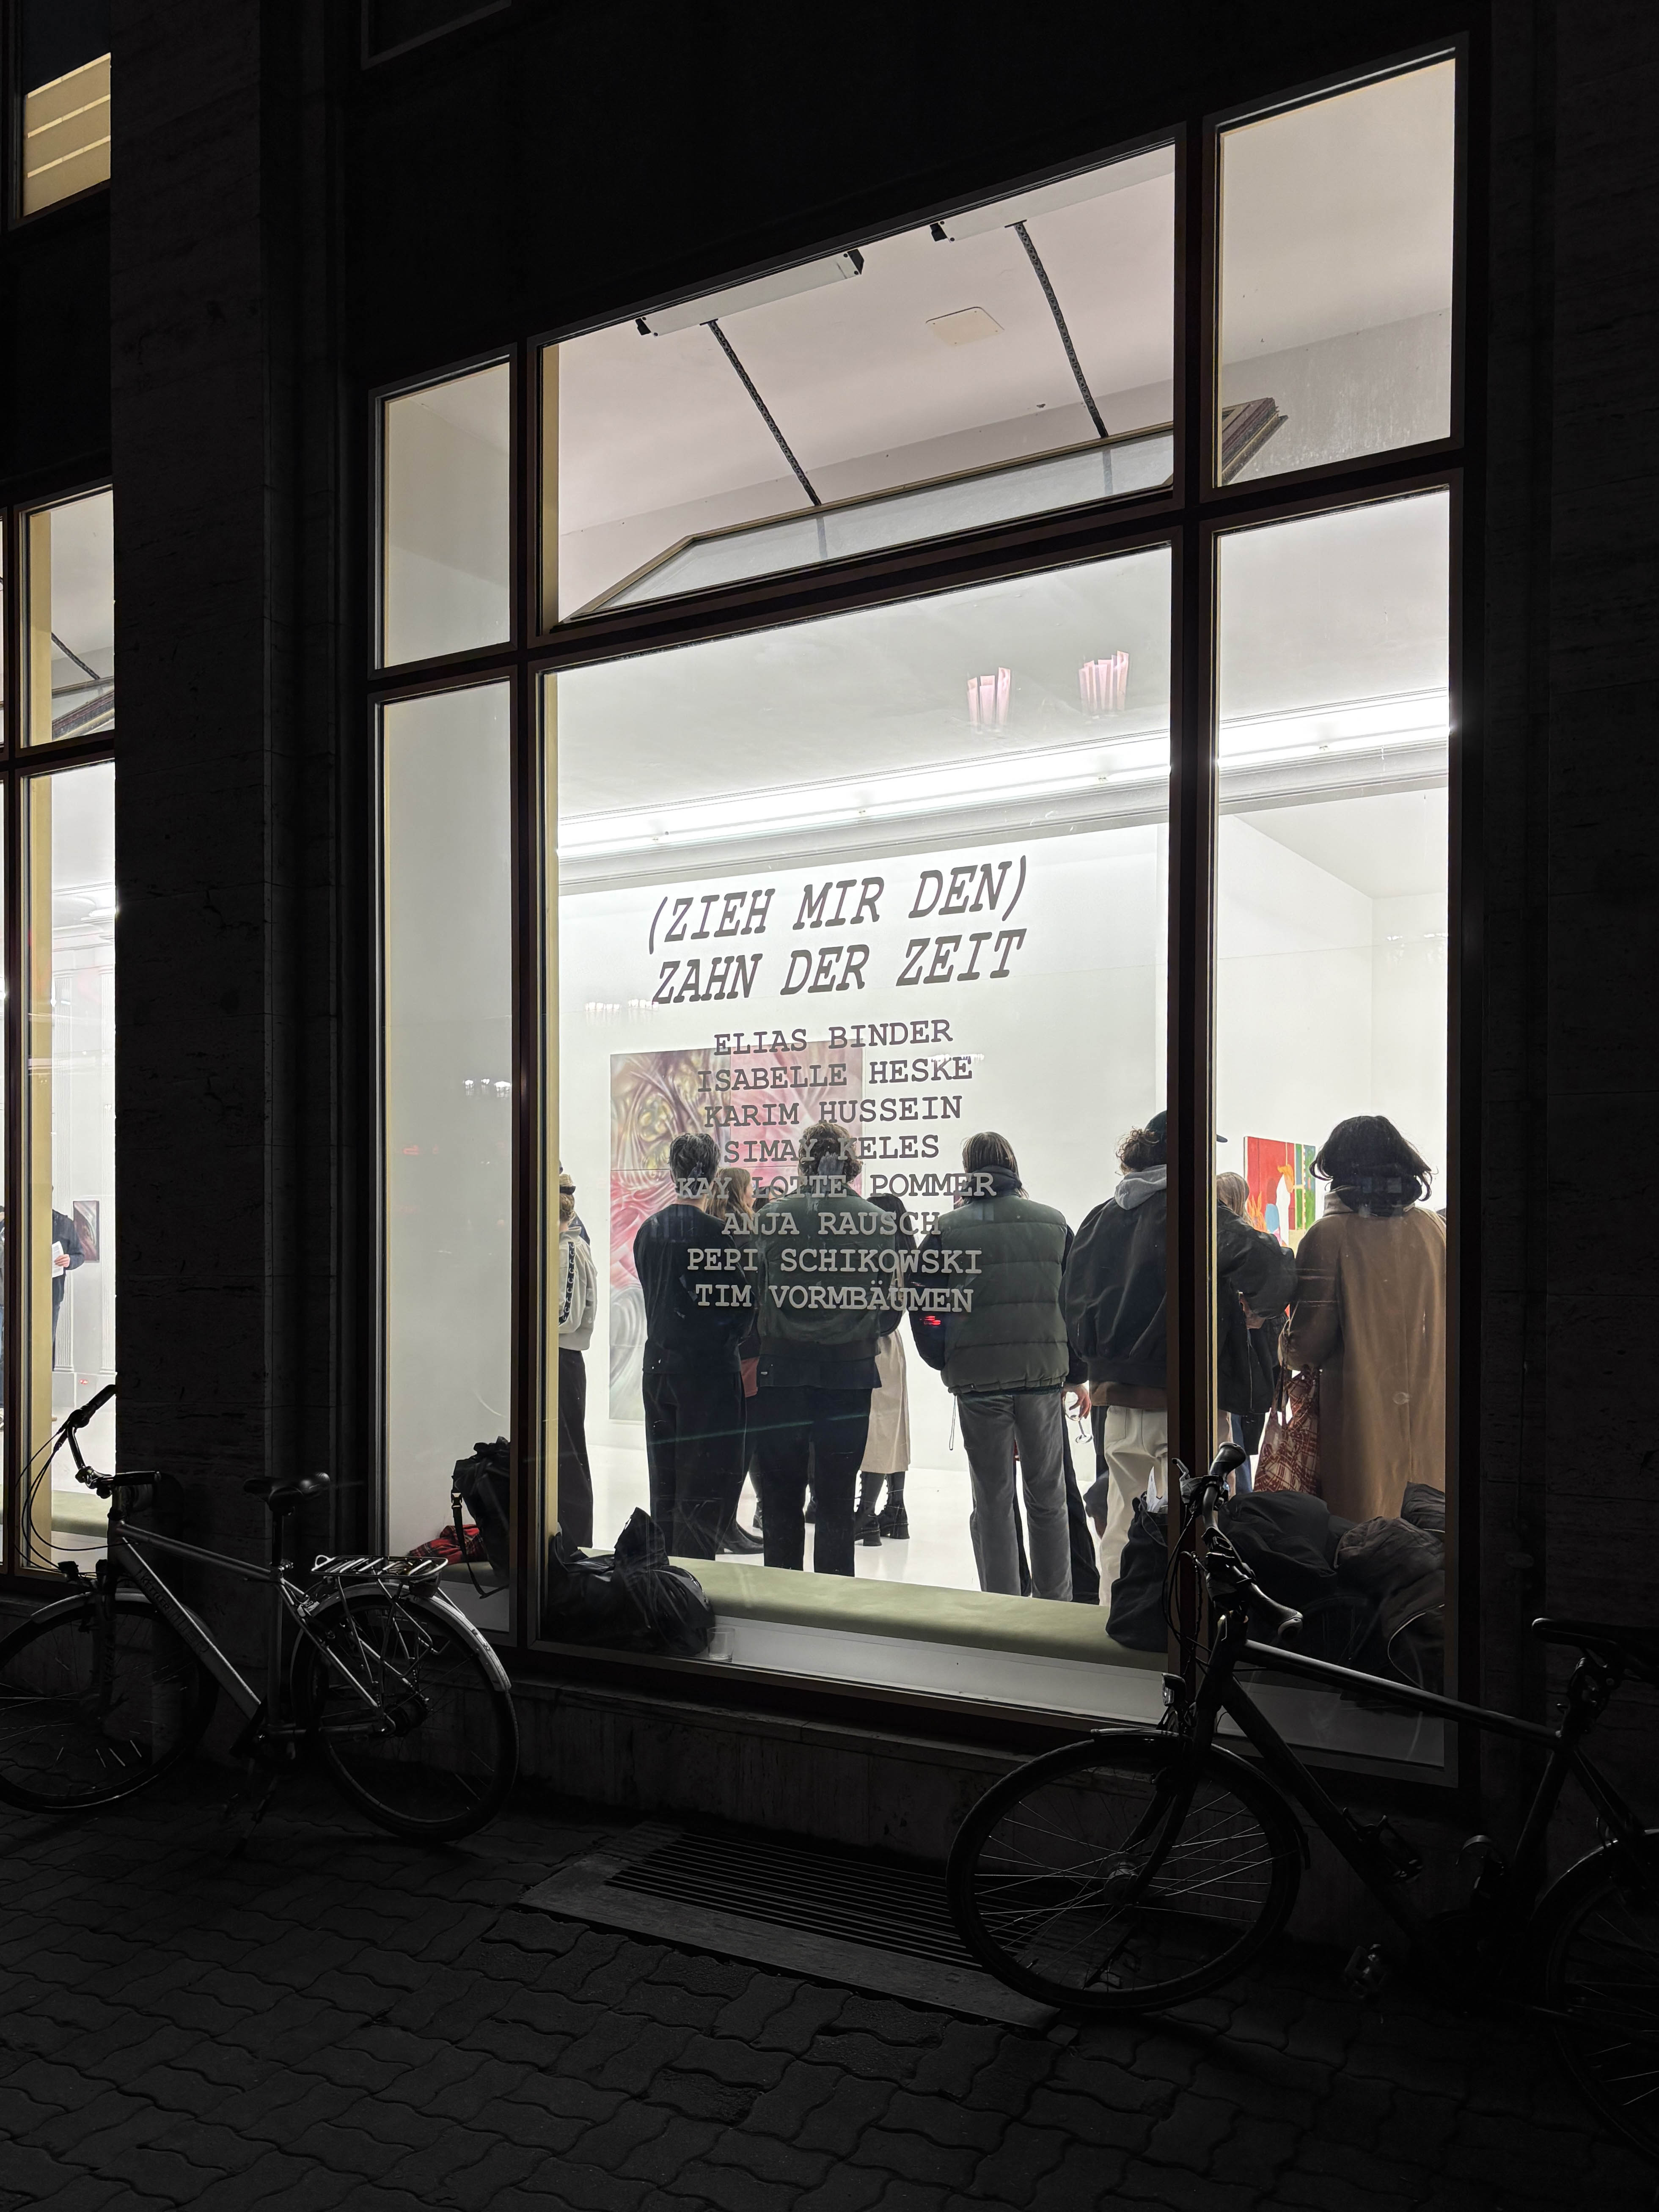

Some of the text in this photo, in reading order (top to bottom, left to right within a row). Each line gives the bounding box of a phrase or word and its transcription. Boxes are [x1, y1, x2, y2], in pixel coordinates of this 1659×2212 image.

[649, 855, 1026, 955] (ZIEH MIR DEN)
[652, 929, 1027, 1005] ZAHN DER ZEIT
[714, 1019, 953, 1056] ELIAS BINDER
[697, 1056, 973, 1092] ISABELLE HESKE
[704, 1095, 963, 1128] KARIM HUSSEIN
[724, 1135, 939, 1163] SIMAY KELES
[677, 1172, 996, 1199] KAY LOTTE POMMER
[721, 1212, 941, 1235] ANJA RAUSCH
[687, 1248, 982, 1274] PEPI SCHIKOWSKI
[695, 1280, 974, 1313] TIM VORMBÄUMEN
